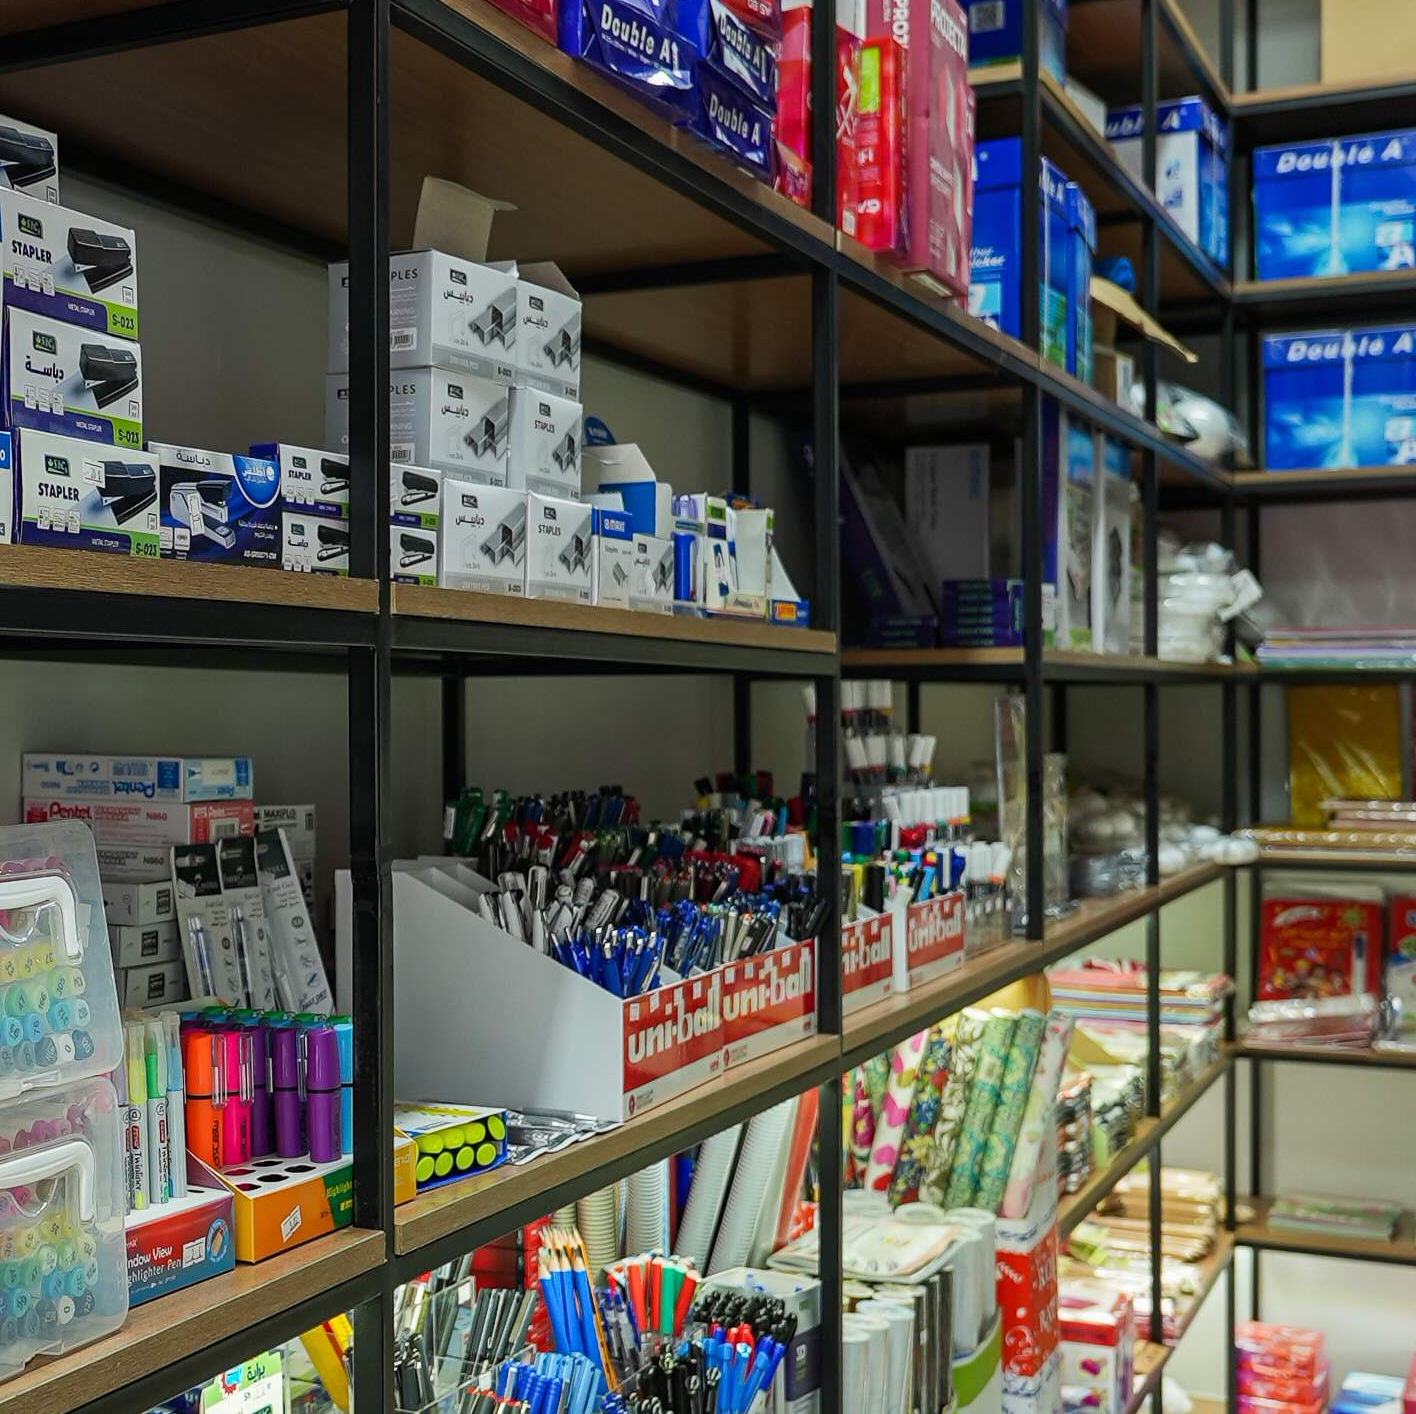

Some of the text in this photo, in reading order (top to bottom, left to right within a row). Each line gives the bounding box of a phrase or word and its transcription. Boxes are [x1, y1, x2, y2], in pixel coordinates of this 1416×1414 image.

[601, 4, 670, 64] Double A
[719, 12, 761, 73] Double A
[709, 93, 760, 146] Double A
[1277, 139, 1403, 175] Double A
[11, 240, 52, 265] STAPLER
[111, 315, 135, 331] S-023
[1287, 333, 1413, 363] Double A
[25, 355, 64, 383] دباسة
[117, 428, 140, 444] S-023
[176, 450, 212, 467] دباسة
[287, 468, 312, 482] STAPLER
[38, 482, 80, 502] STAPLER
[537, 523, 562, 537] STAPLES
[135, 540, 158, 558] S-023
[114, 780, 156, 799] Pentel
[49, 800, 92, 820] Pentel
[143, 855, 165, 866] N860
[907, 905, 965, 953] uni-ball
[722, 948, 812, 1023] uni-ball
[628, 973, 721, 1064] uni-ball
[152, 1245, 174, 1261] View
[167, 1258, 182, 1272] Pen
